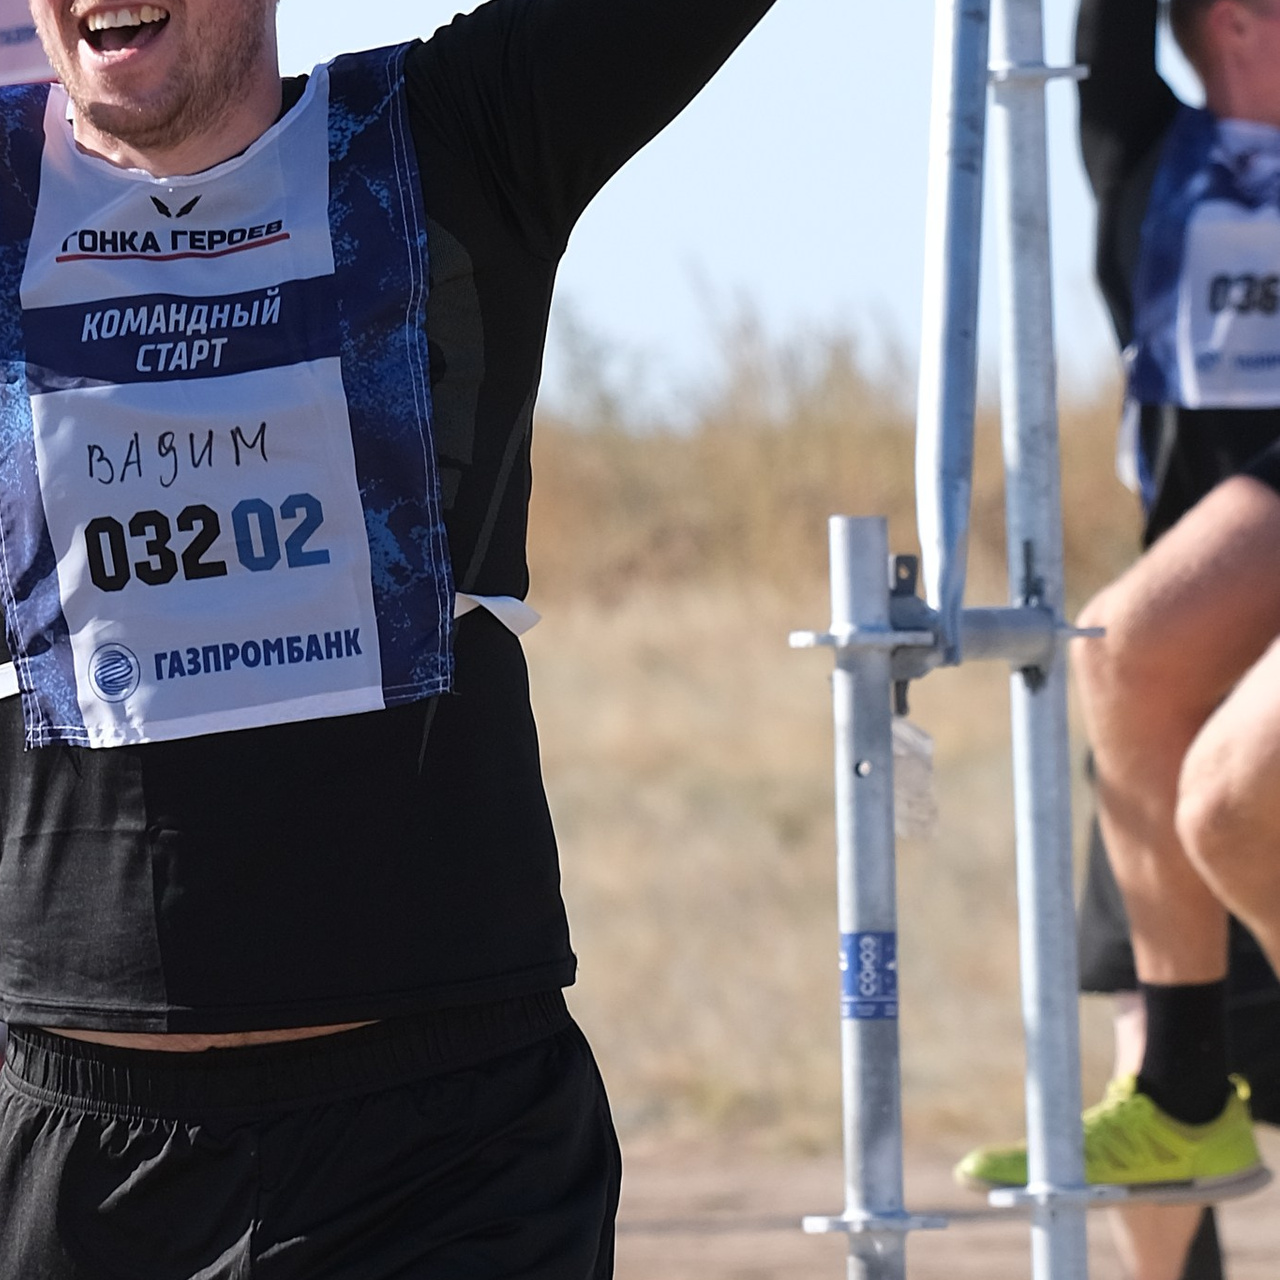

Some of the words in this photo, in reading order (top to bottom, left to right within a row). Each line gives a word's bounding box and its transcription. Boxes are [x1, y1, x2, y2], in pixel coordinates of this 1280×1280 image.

[61, 229, 161, 253] ГОНКА
[171, 219, 283, 251] ГЕРОЕВ
[81, 287, 281, 342] КОМАНДНЫЙ
[135, 337, 228, 372] СТАРТ
[84, 493, 331, 592] 03202
[154, 628, 363, 680] ГАЗПРОМБАНК
